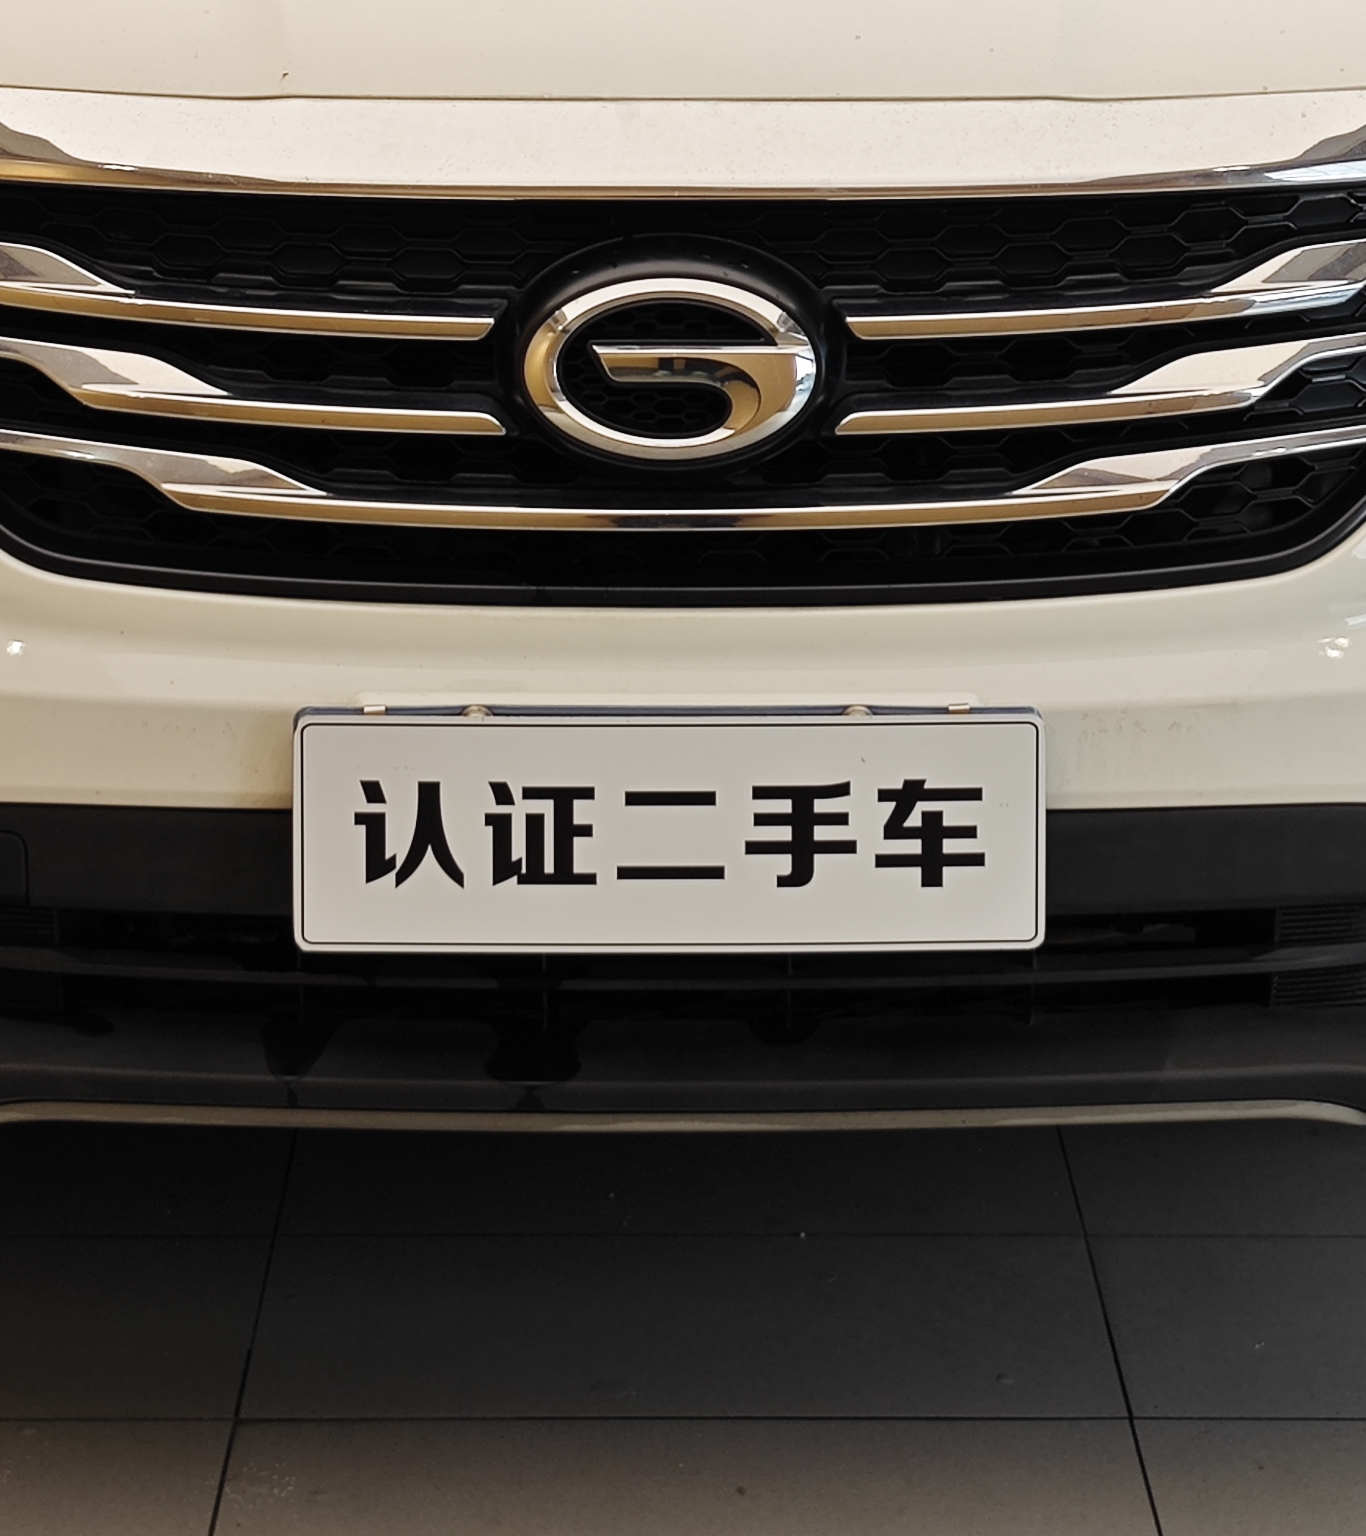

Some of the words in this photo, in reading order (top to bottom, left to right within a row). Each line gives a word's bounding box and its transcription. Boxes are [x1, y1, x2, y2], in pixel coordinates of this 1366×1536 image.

[353, 779, 987, 889] 认证二手车
